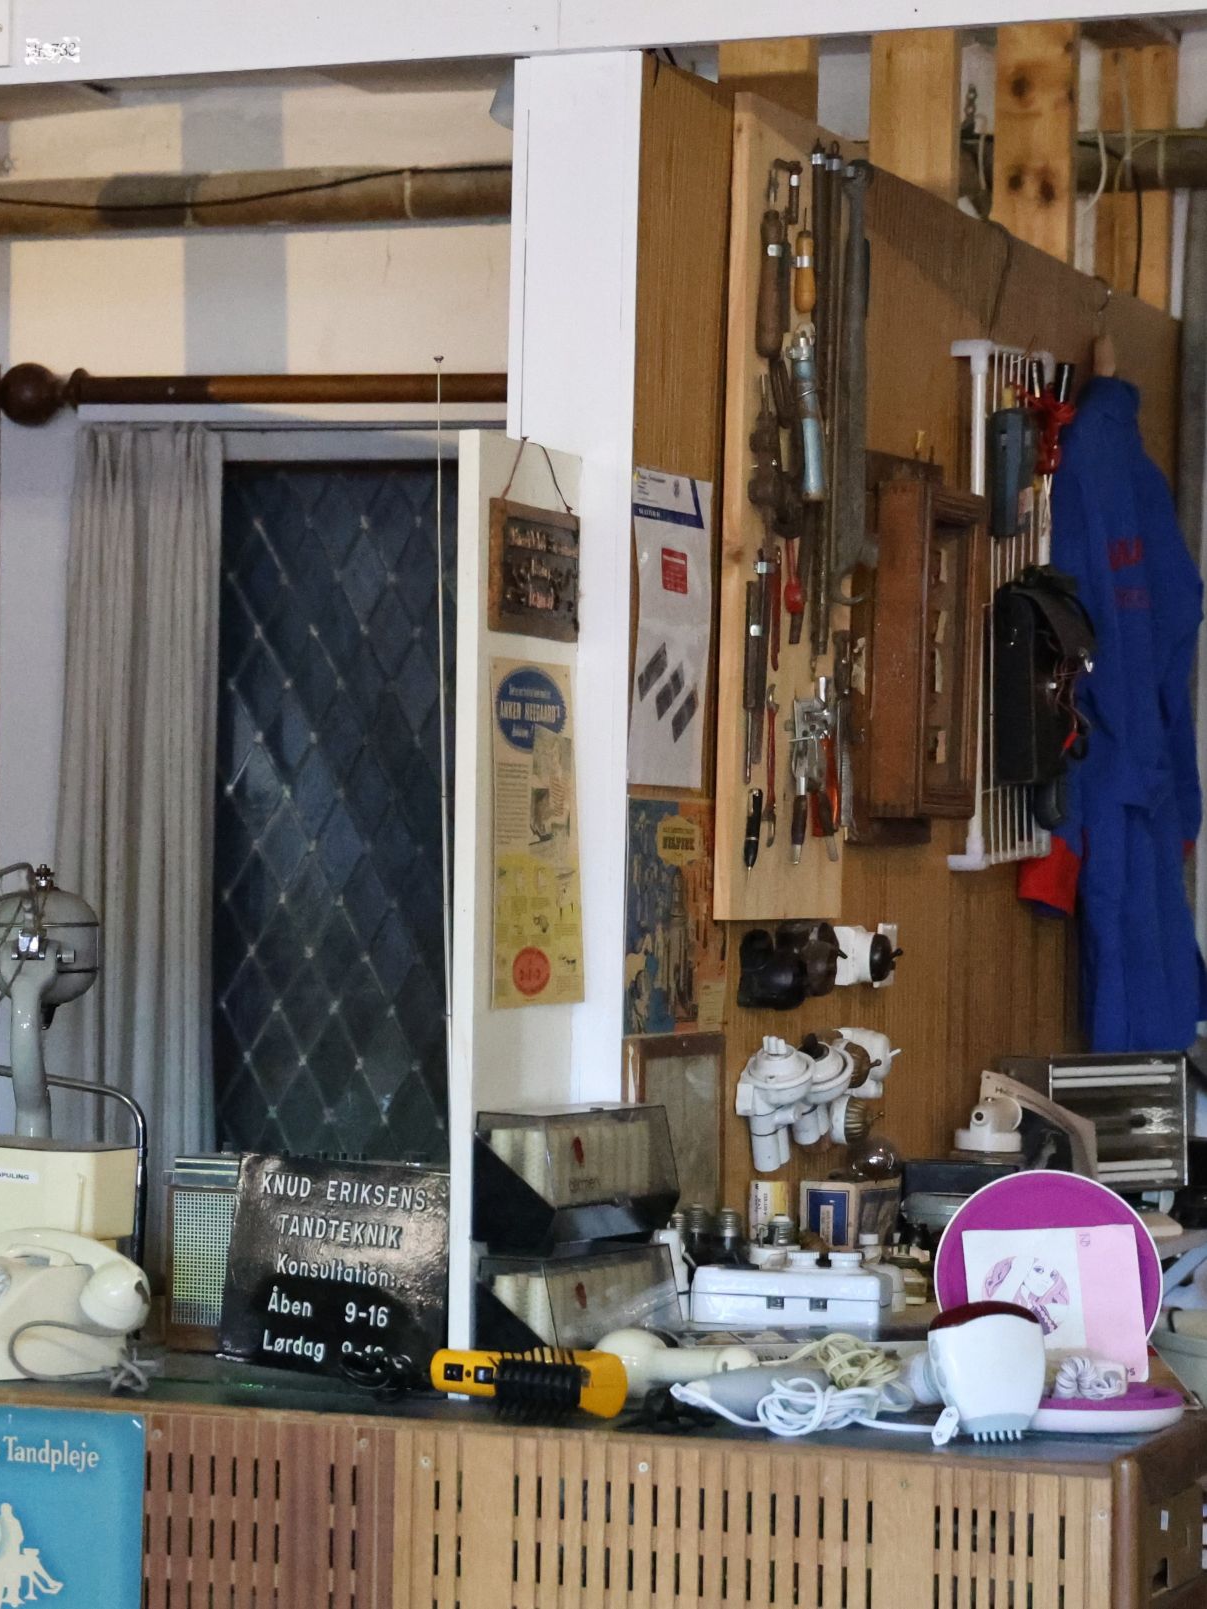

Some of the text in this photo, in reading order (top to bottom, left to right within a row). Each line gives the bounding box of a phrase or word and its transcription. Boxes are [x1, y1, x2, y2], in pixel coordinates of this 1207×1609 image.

[261, 1173, 428, 1212] KNUD ERIKSENS
[277, 1214, 403, 1249] TANDTEKNIK
[276, 1253, 396, 1288] Konsultation:
[267, 1285, 390, 1328] Åben 9-16
[262, 1329, 326, 1363] Lørdag
[2, 1435, 100, 1473] Tandpleje
